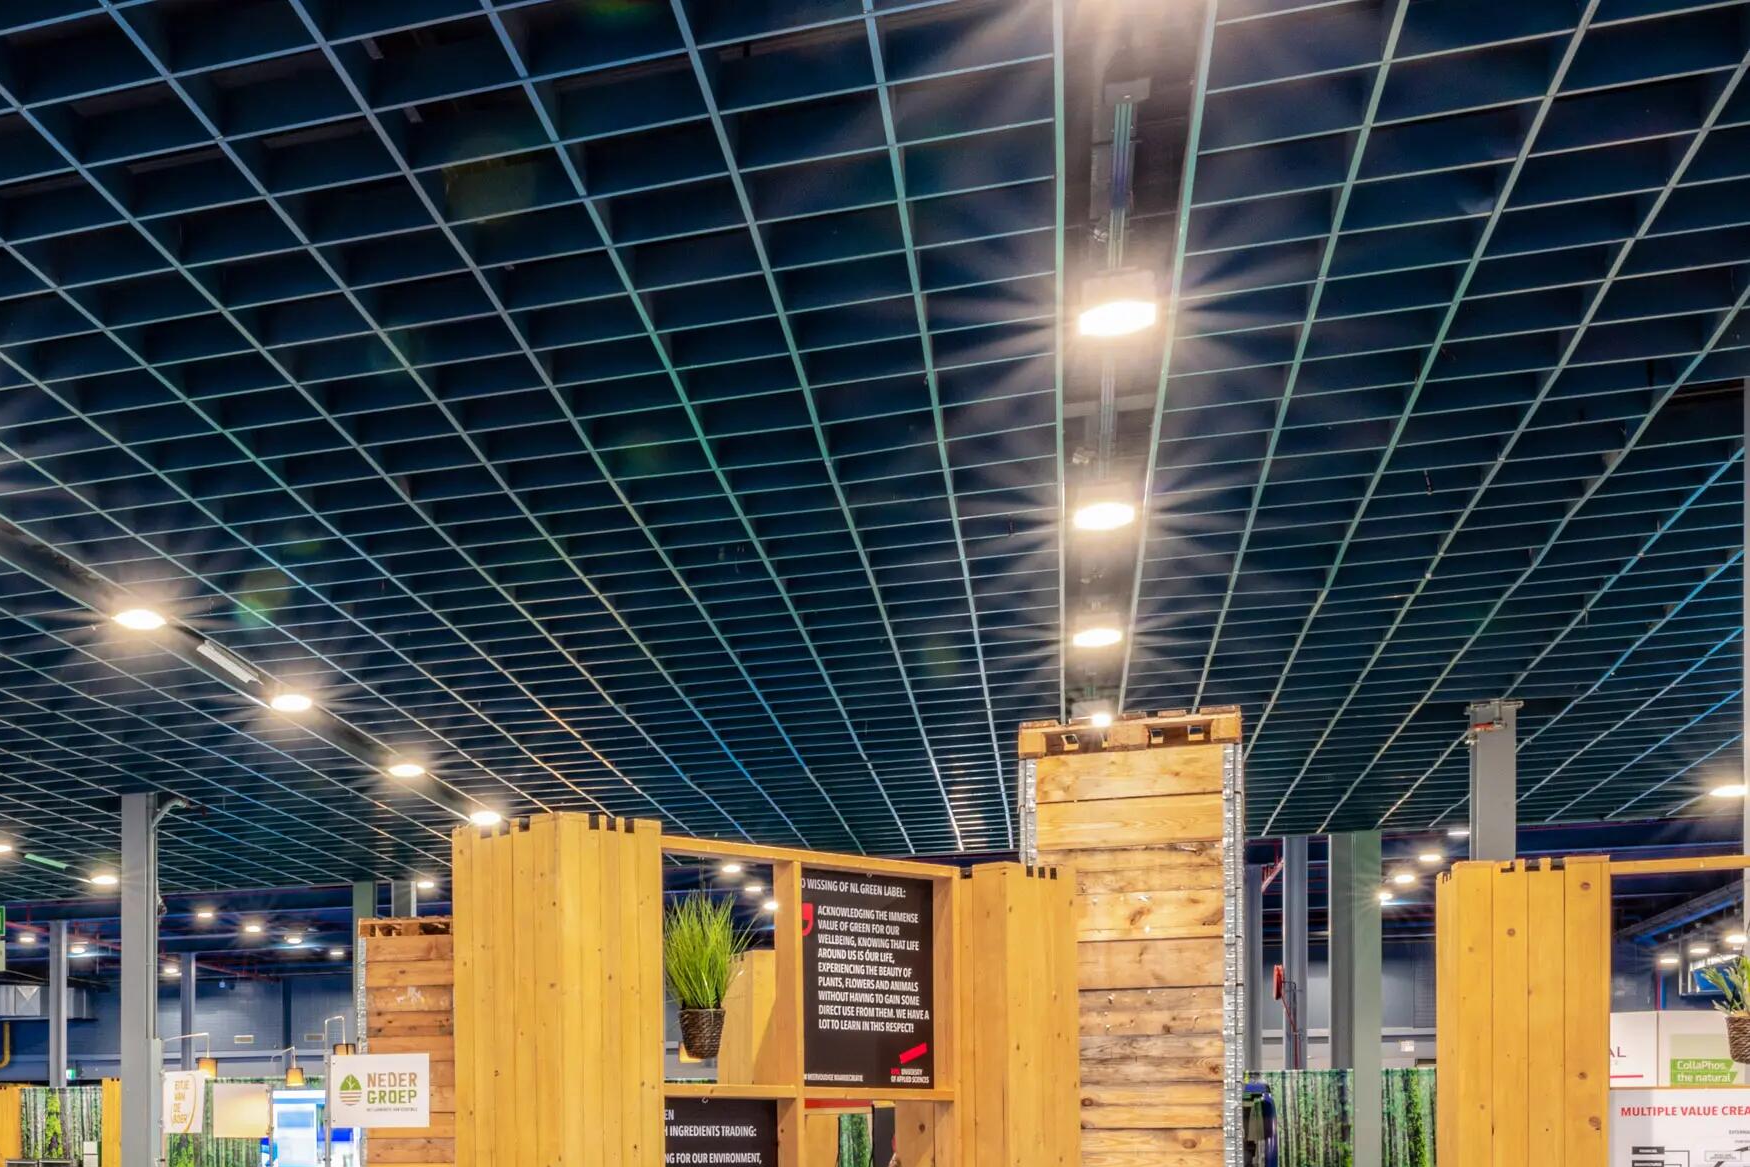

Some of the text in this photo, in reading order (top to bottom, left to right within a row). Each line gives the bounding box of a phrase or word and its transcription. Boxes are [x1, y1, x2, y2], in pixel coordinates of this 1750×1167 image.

[807, 878, 906, 899] WISSING OF NL GREEN LABEL:
[818, 905, 919, 924] ACKNOWLEDGING THE IMMENSE
[818, 919, 900, 936] VALUE OF GREEN FOR OUR
[818, 933, 920, 951] WELLBEING, KNOWING THAT LIFE
[818, 948, 847, 960] AROUND
[847, 950, 857, 961] US
[857, 950, 864, 961] IS
[880, 952, 895, 964] LIFE,
[818, 962, 912, 978] EXPERIENCING THE BEAUTY OF
[818, 976, 919, 992] PLANTS, FLOWERS AND ANIMALS
[818, 990, 920, 1006] WITHOUT HAVING TO GAIN SOME
[818, 1005, 930, 1020] DIRECT USE FROM THEM. WE HAVE A
[818, 1018, 915, 1033] LOT TO LEARN IN THIS RESPECT!
[367, 1072, 418, 1088] NEDER
[1677, 1073, 1731, 1083] the natural
[367, 1089, 417, 1105] GROEP
[1621, 1106, 1678, 1117] MULTIPLE
[1680, 1106, 1719, 1116] VALUE
[670, 1125, 757, 1137] INGREDIENTS TRADING:
[676, 1153, 691, 1164] FOR
[692, 1153, 708, 1164] OUR
[709, 1152, 762, 1165] ENVIRONMENT,
